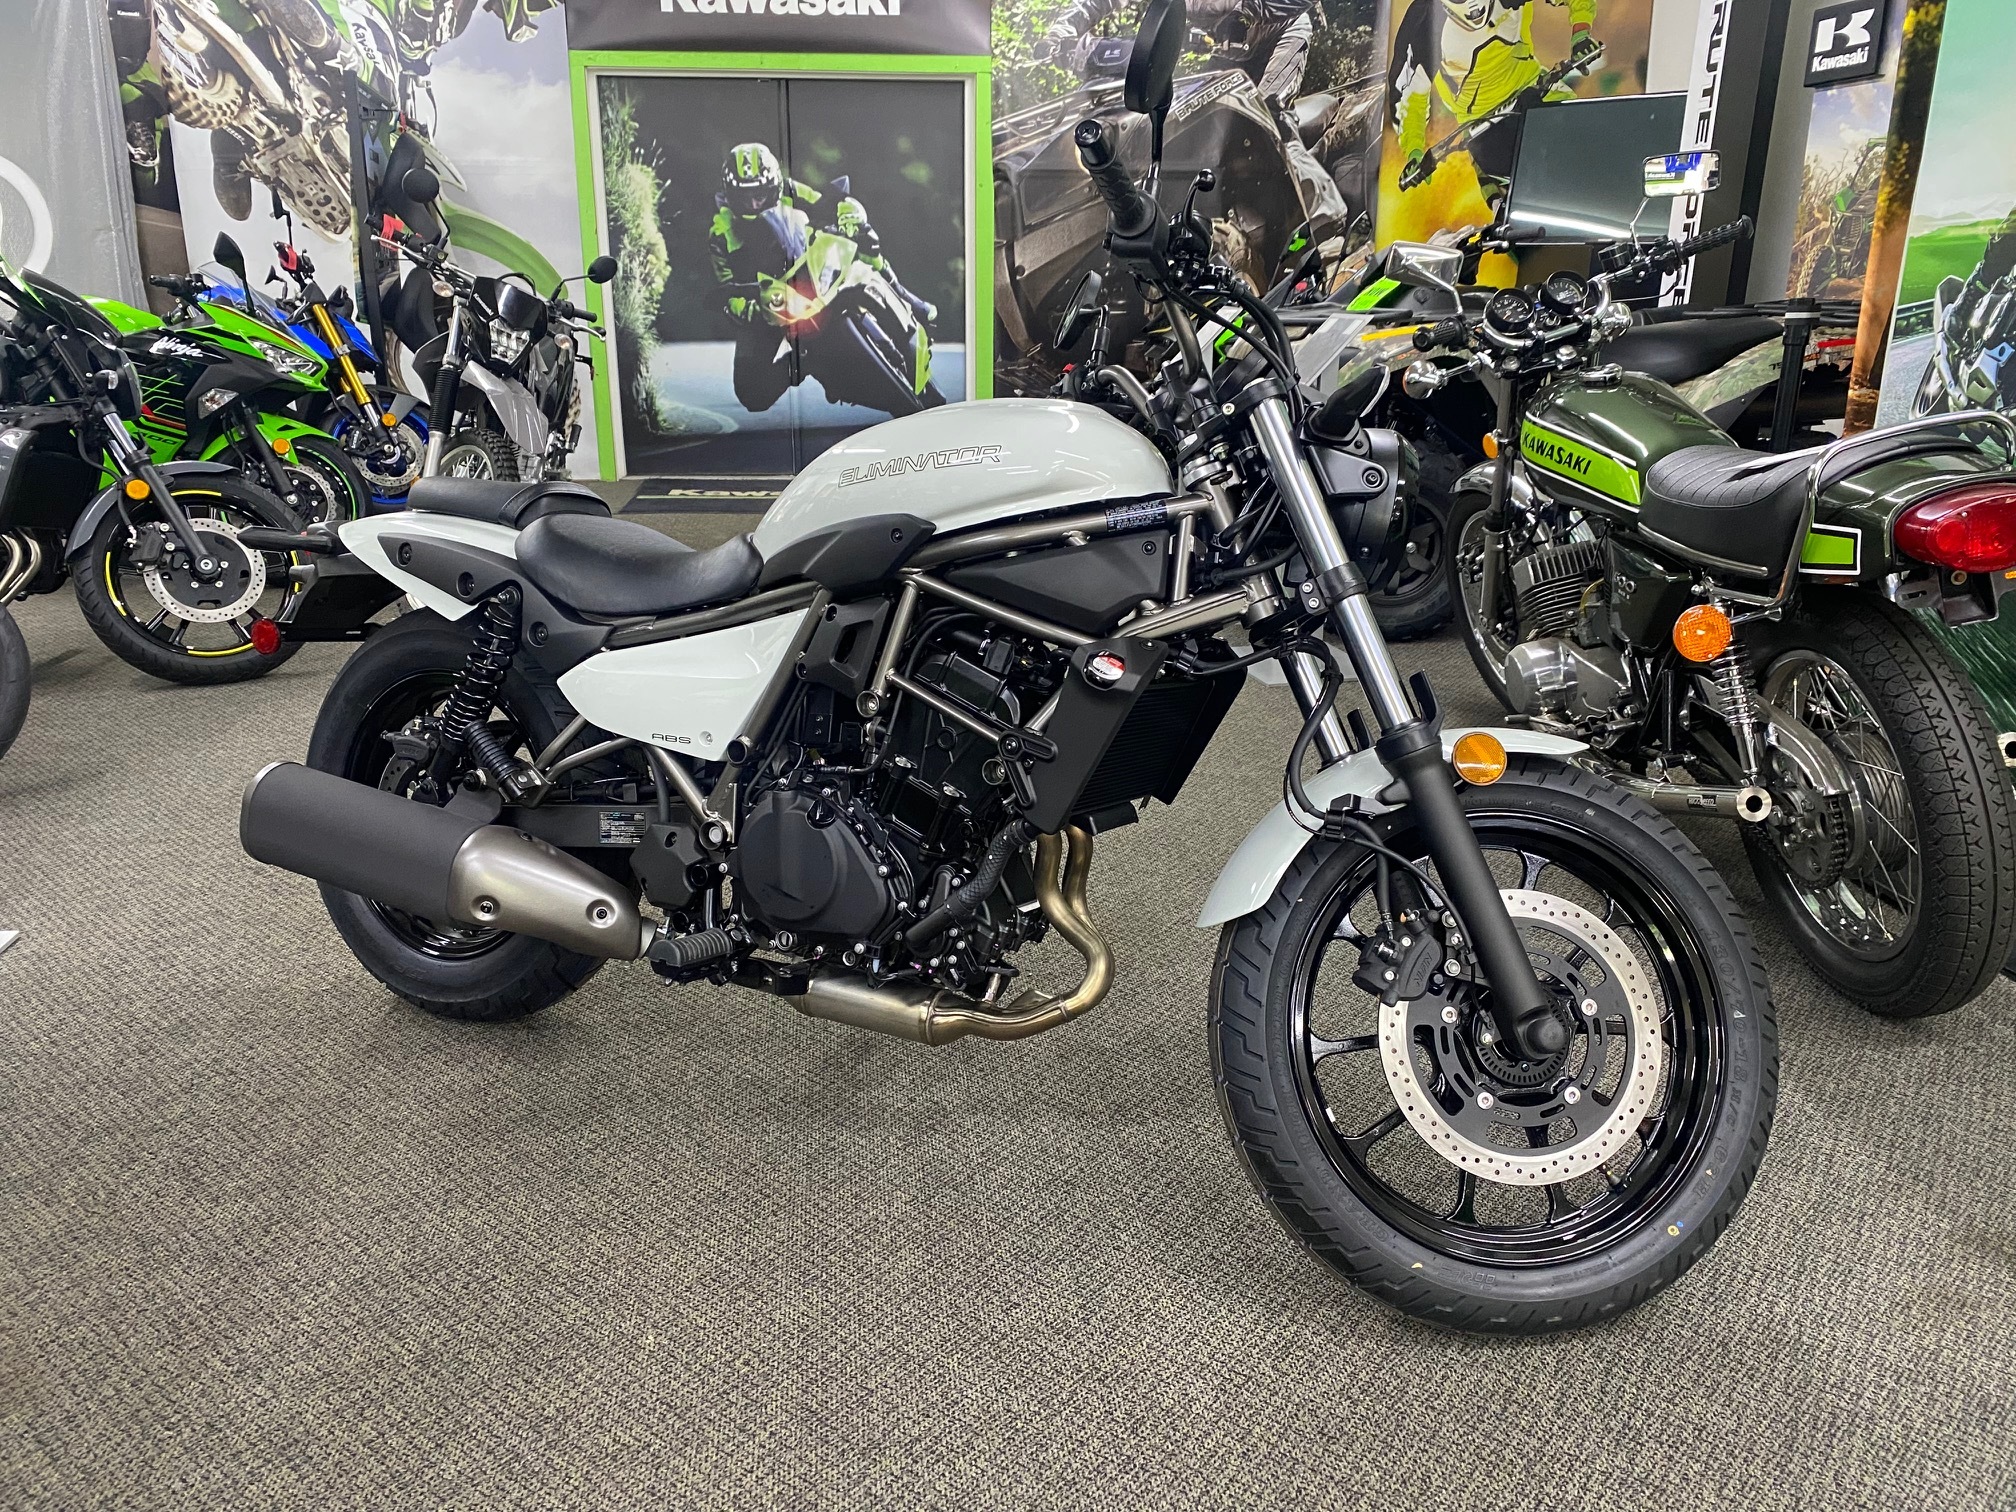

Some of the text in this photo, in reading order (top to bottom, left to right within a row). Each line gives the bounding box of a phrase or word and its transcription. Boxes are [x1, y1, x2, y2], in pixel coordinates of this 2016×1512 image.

[1811, 46, 1870, 73] Kawasaki
[1175, 72, 1245, 121] BRUTE FORCE
[148, 335, 215, 359] Ninja
[837, 444, 1003, 488] ELIMINATOR
[1522, 431, 1592, 476] KAWASAKI
[651, 732, 692, 745] ABS
